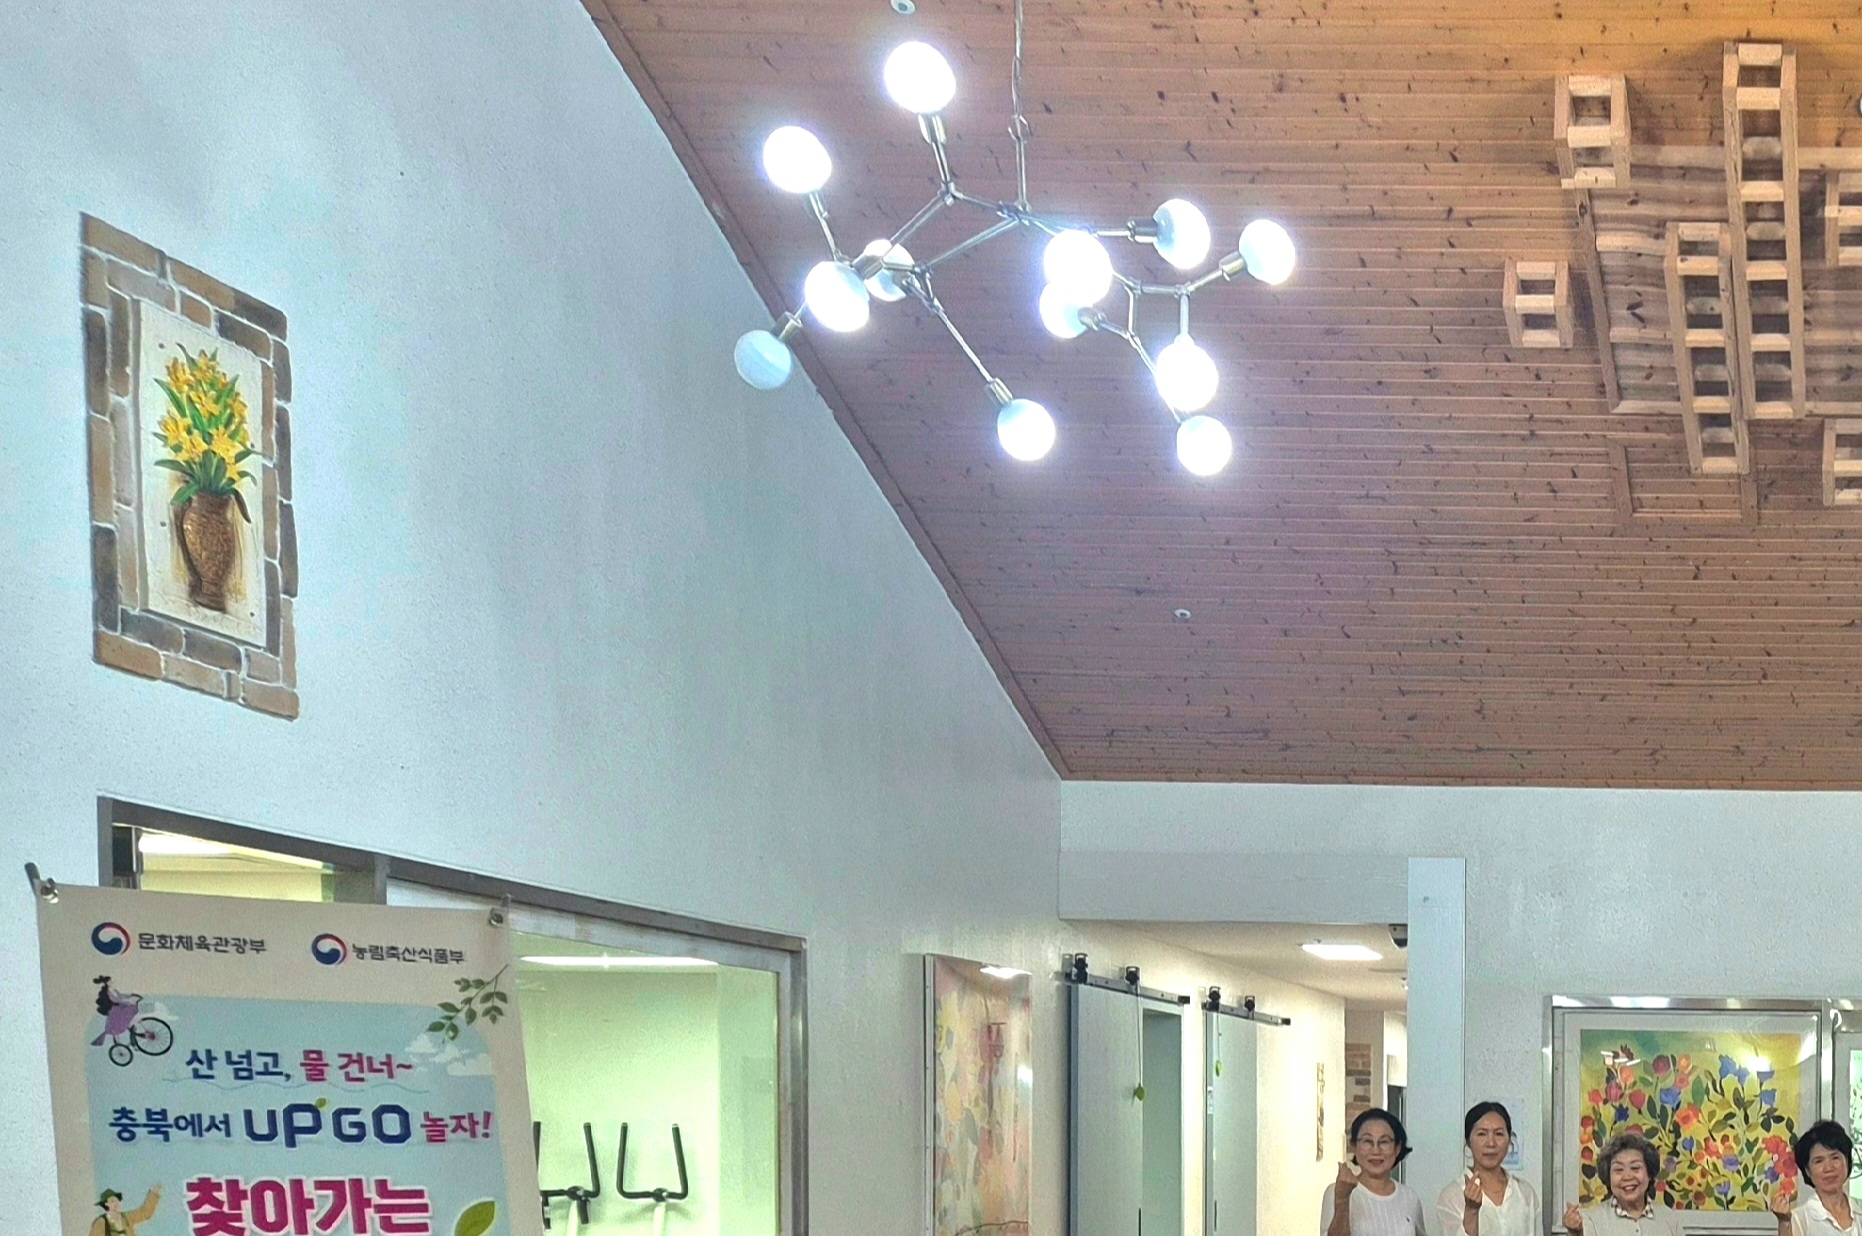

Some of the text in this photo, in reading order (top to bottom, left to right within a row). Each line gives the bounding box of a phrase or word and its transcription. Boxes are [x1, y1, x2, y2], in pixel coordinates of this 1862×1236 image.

[138, 933, 267, 953] 문화체육관광부
[352, 943, 464, 964] 농림축산식품부
[186, 1050, 412, 1081] 산 넘고, 물 건너~
[109, 1108, 231, 1141] 충북에서
[421, 1111, 492, 1142] 놀자!
